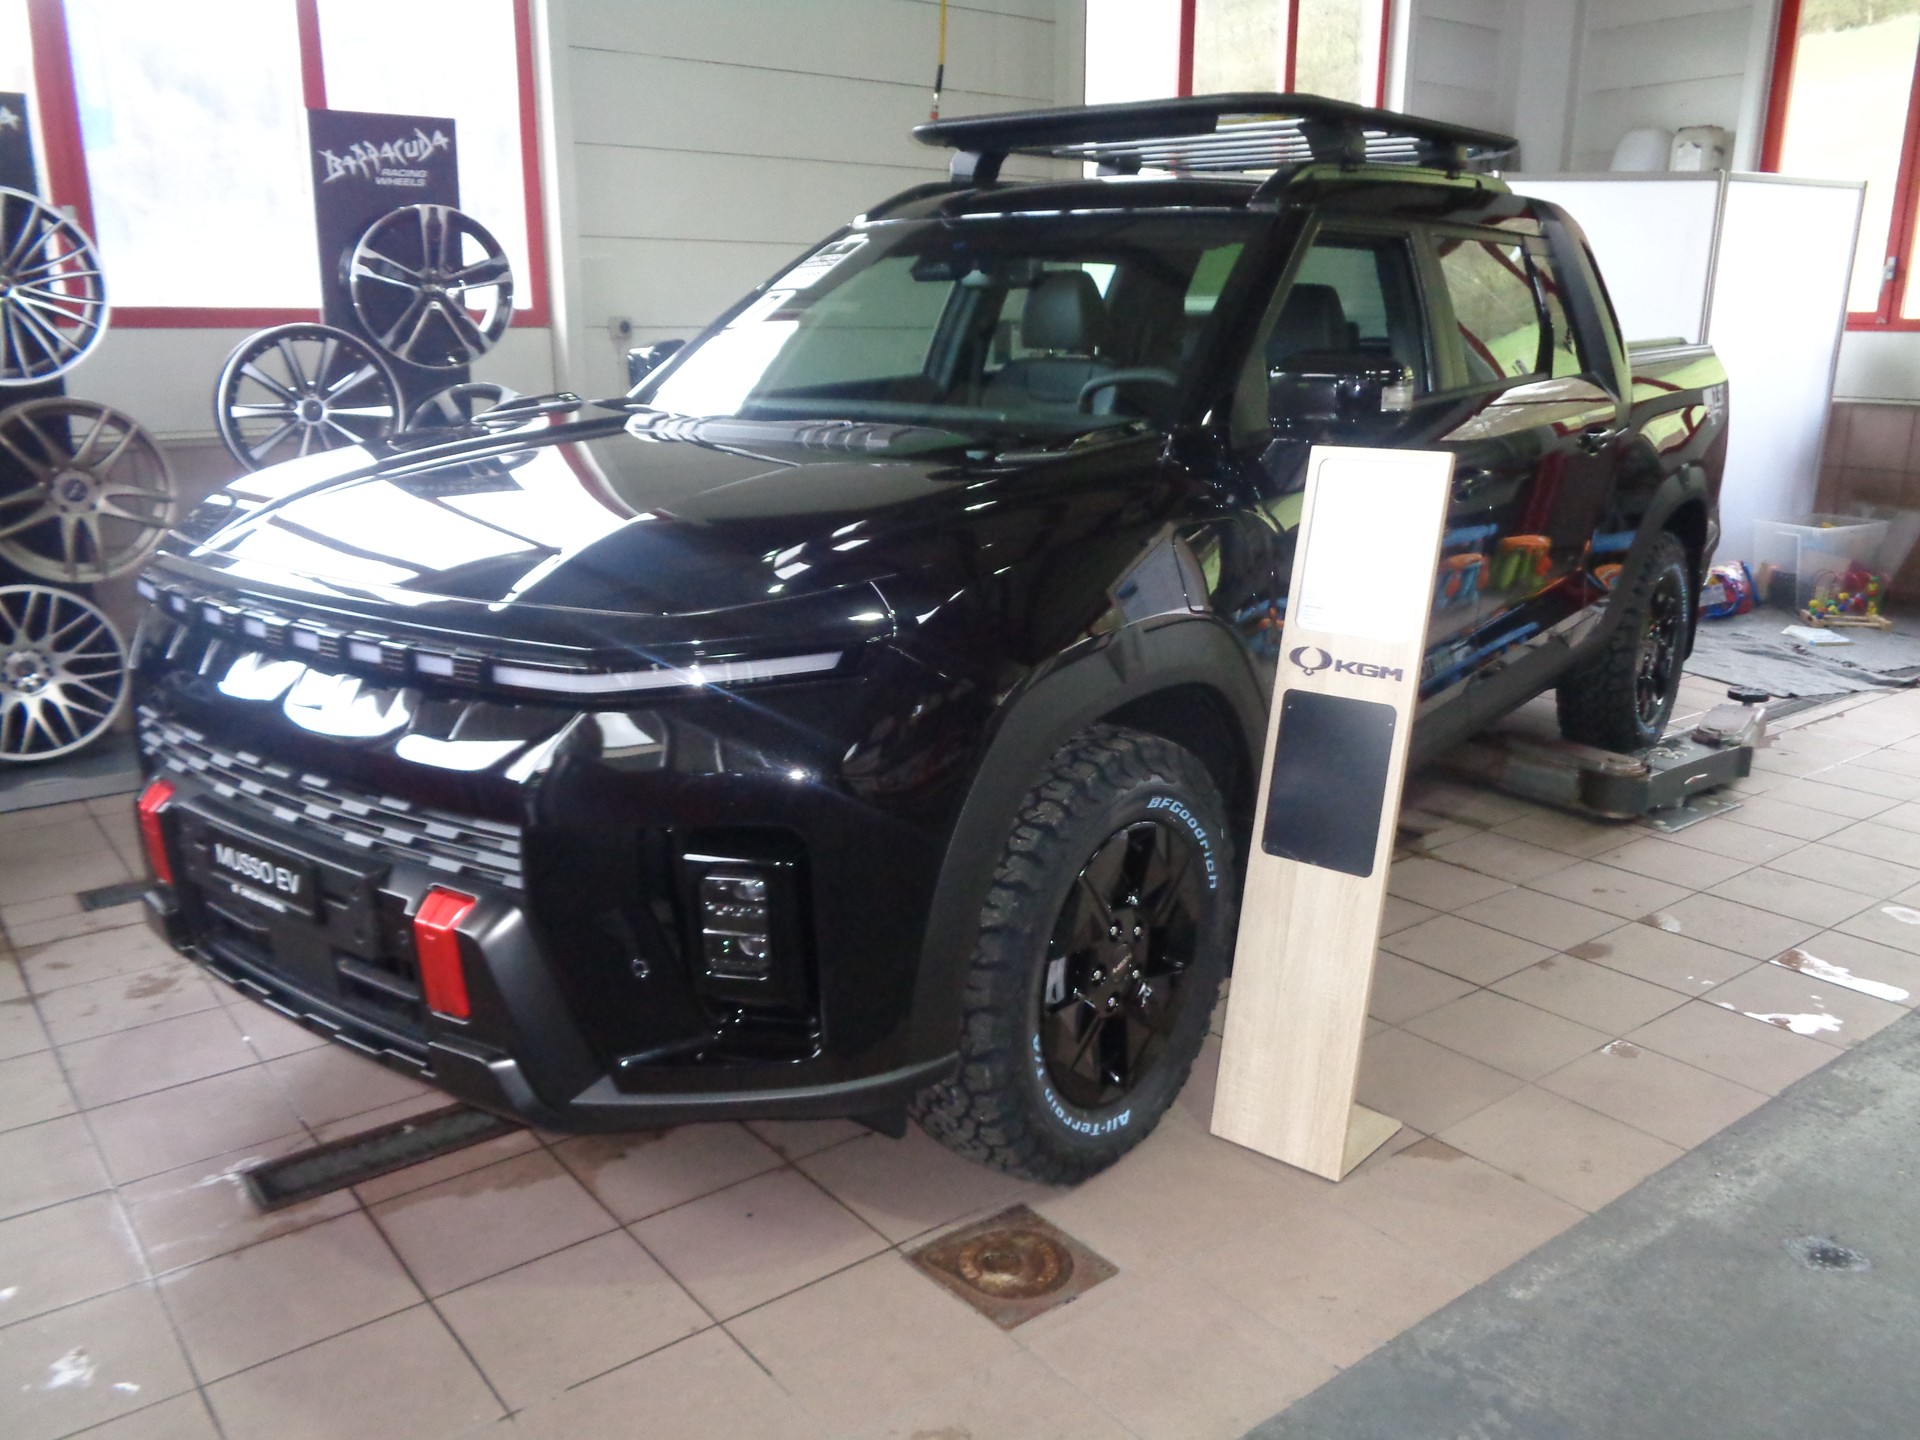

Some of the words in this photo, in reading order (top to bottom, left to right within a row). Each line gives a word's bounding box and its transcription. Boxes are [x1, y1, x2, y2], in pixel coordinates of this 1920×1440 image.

[318, 127, 449, 184] BARRACUDA
[381, 168, 429, 178] RACING
[375, 176, 426, 187] WHEELS
[1334, 659, 1404, 682] KGM
[1146, 797, 1218, 889] BFGoodrich
[214, 843, 275, 884] MUSSO
[275, 866, 300, 895] EV
[1044, 1088, 1131, 1136] All-Terrain
